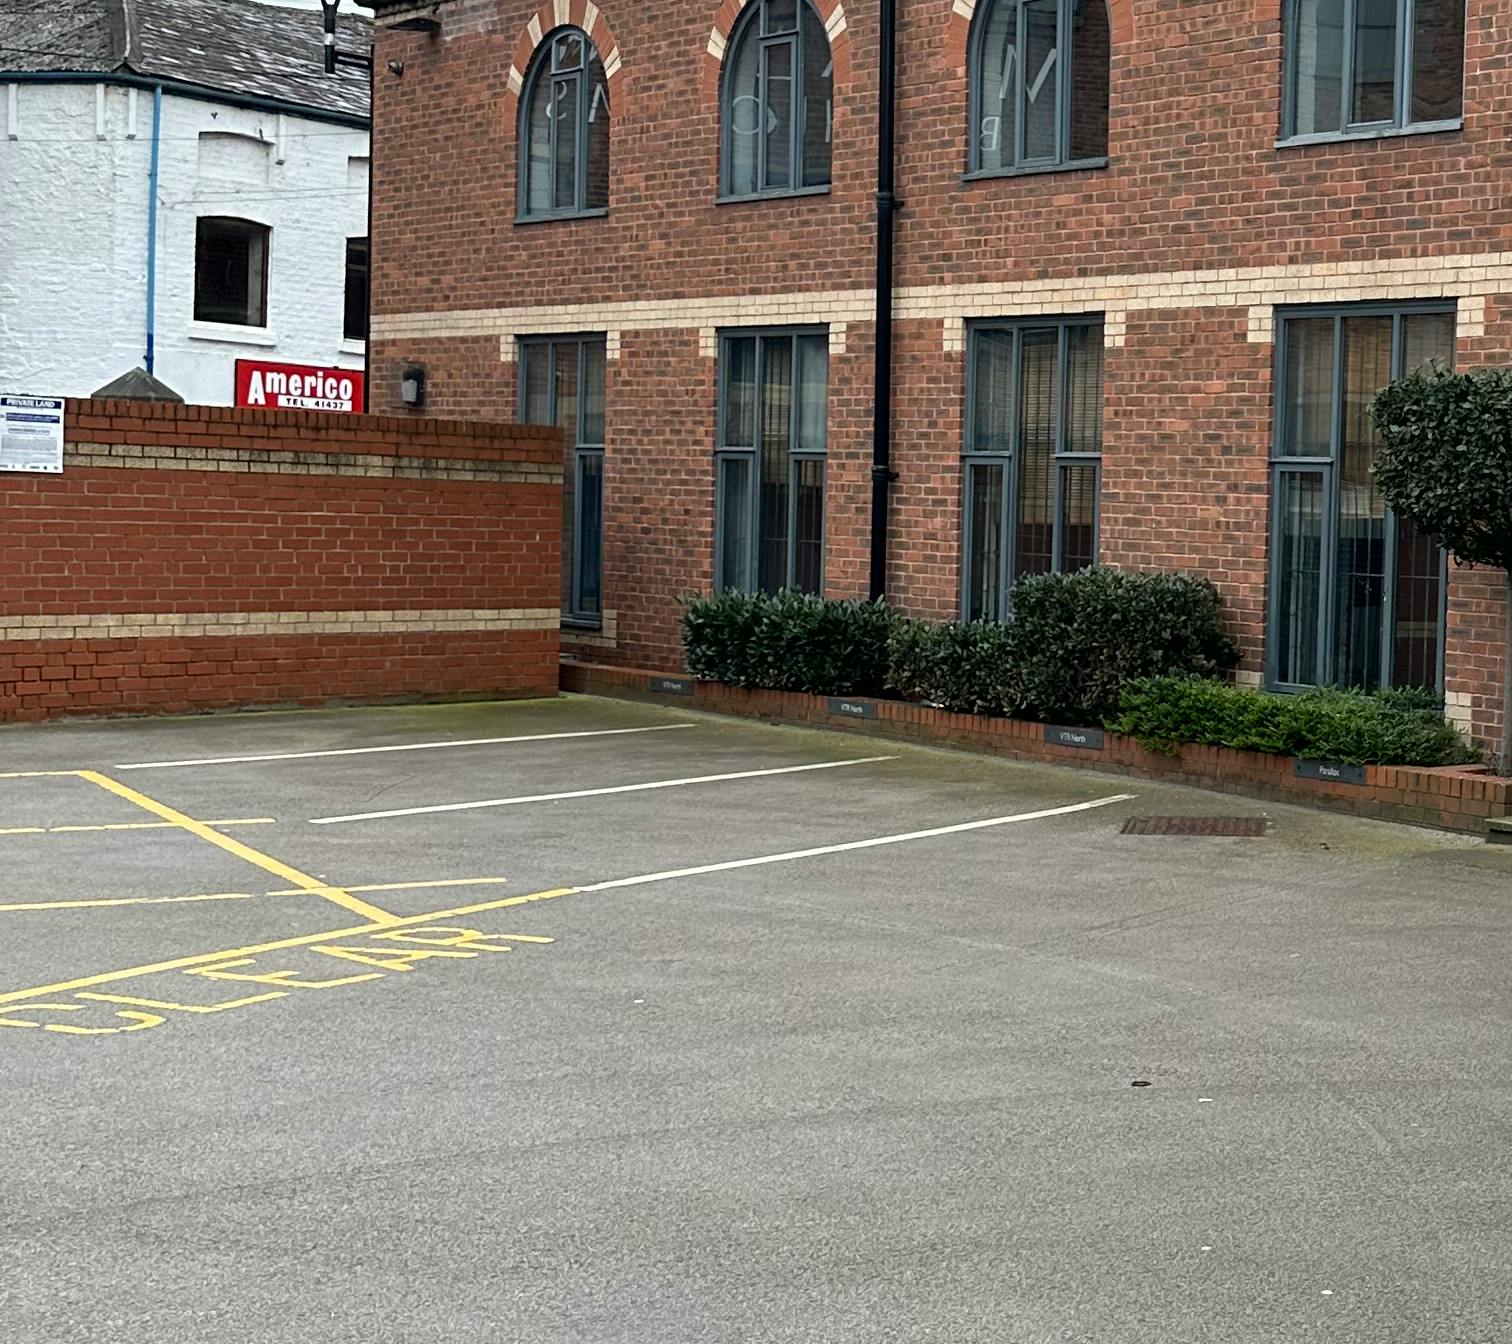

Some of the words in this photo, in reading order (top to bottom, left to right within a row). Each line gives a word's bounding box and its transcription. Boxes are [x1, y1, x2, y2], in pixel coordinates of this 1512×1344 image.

[247, 370, 353, 405] Americo
[35, 400, 56, 408] LAND
[1059, 731, 1071, 741] VTR
